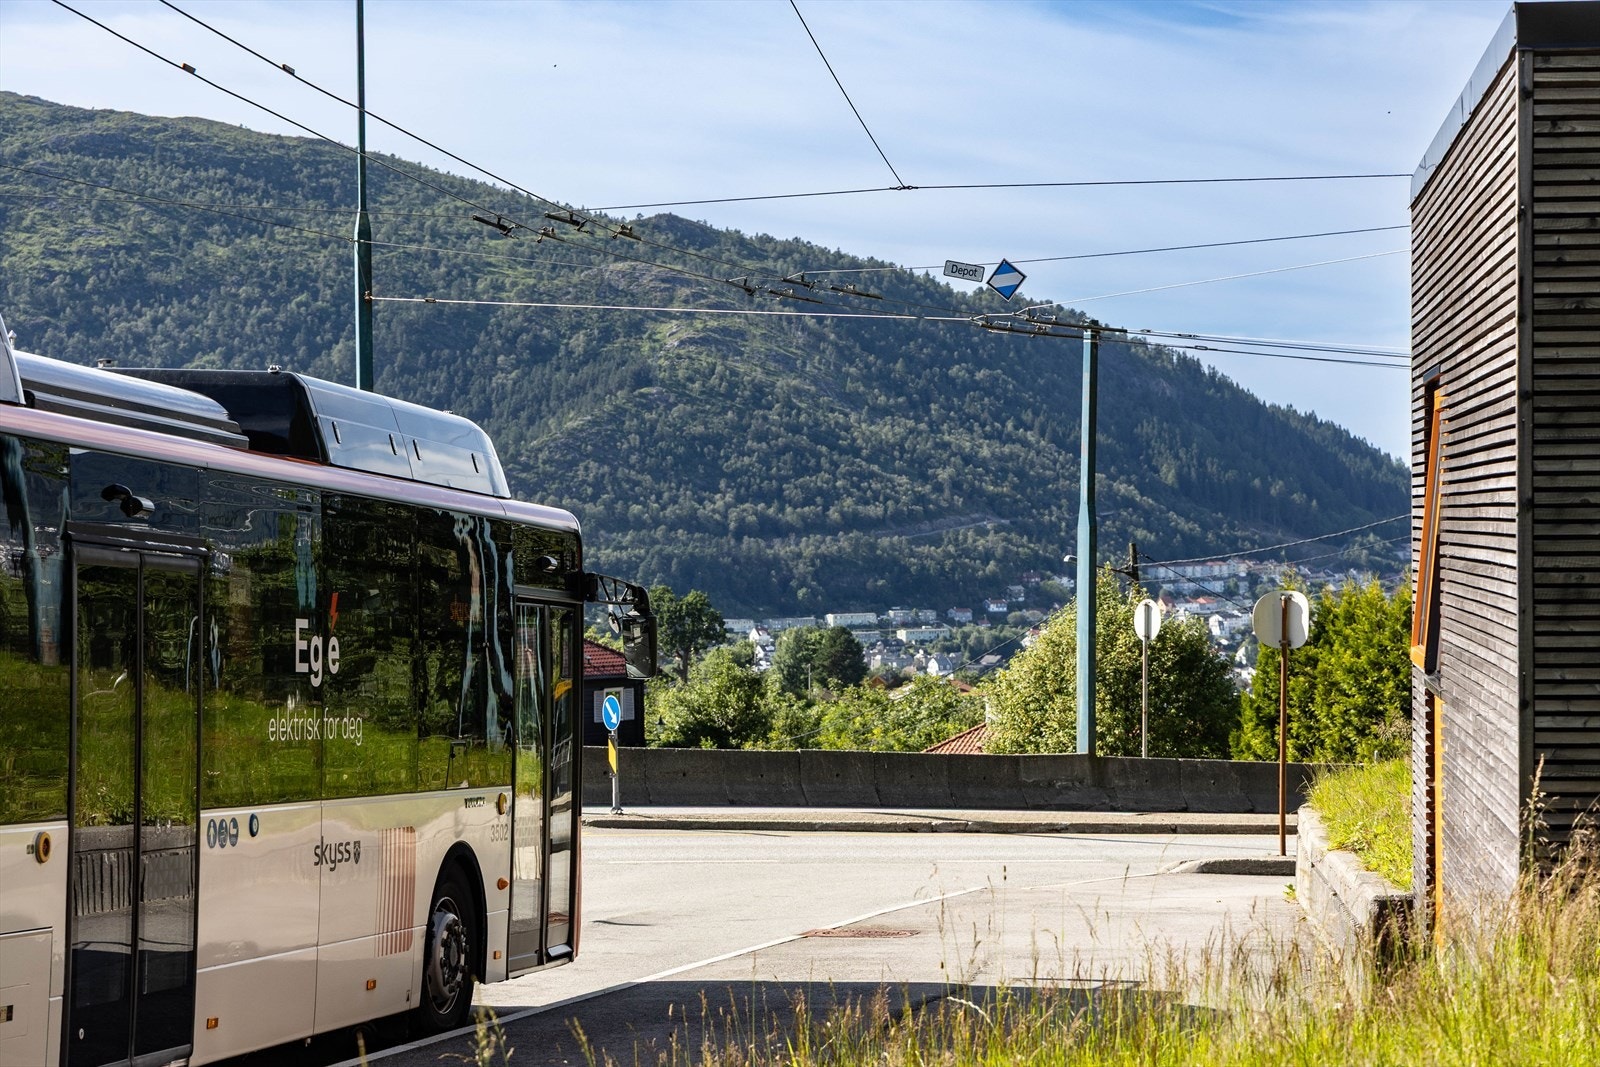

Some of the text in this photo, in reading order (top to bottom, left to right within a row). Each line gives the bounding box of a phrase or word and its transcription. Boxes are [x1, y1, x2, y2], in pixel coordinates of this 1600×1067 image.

[951, 264, 978, 277] Depot
[268, 707, 363, 746] elektrisk for deg
[490, 823, 509, 842] 3502
[313, 836, 351, 872] skyss
